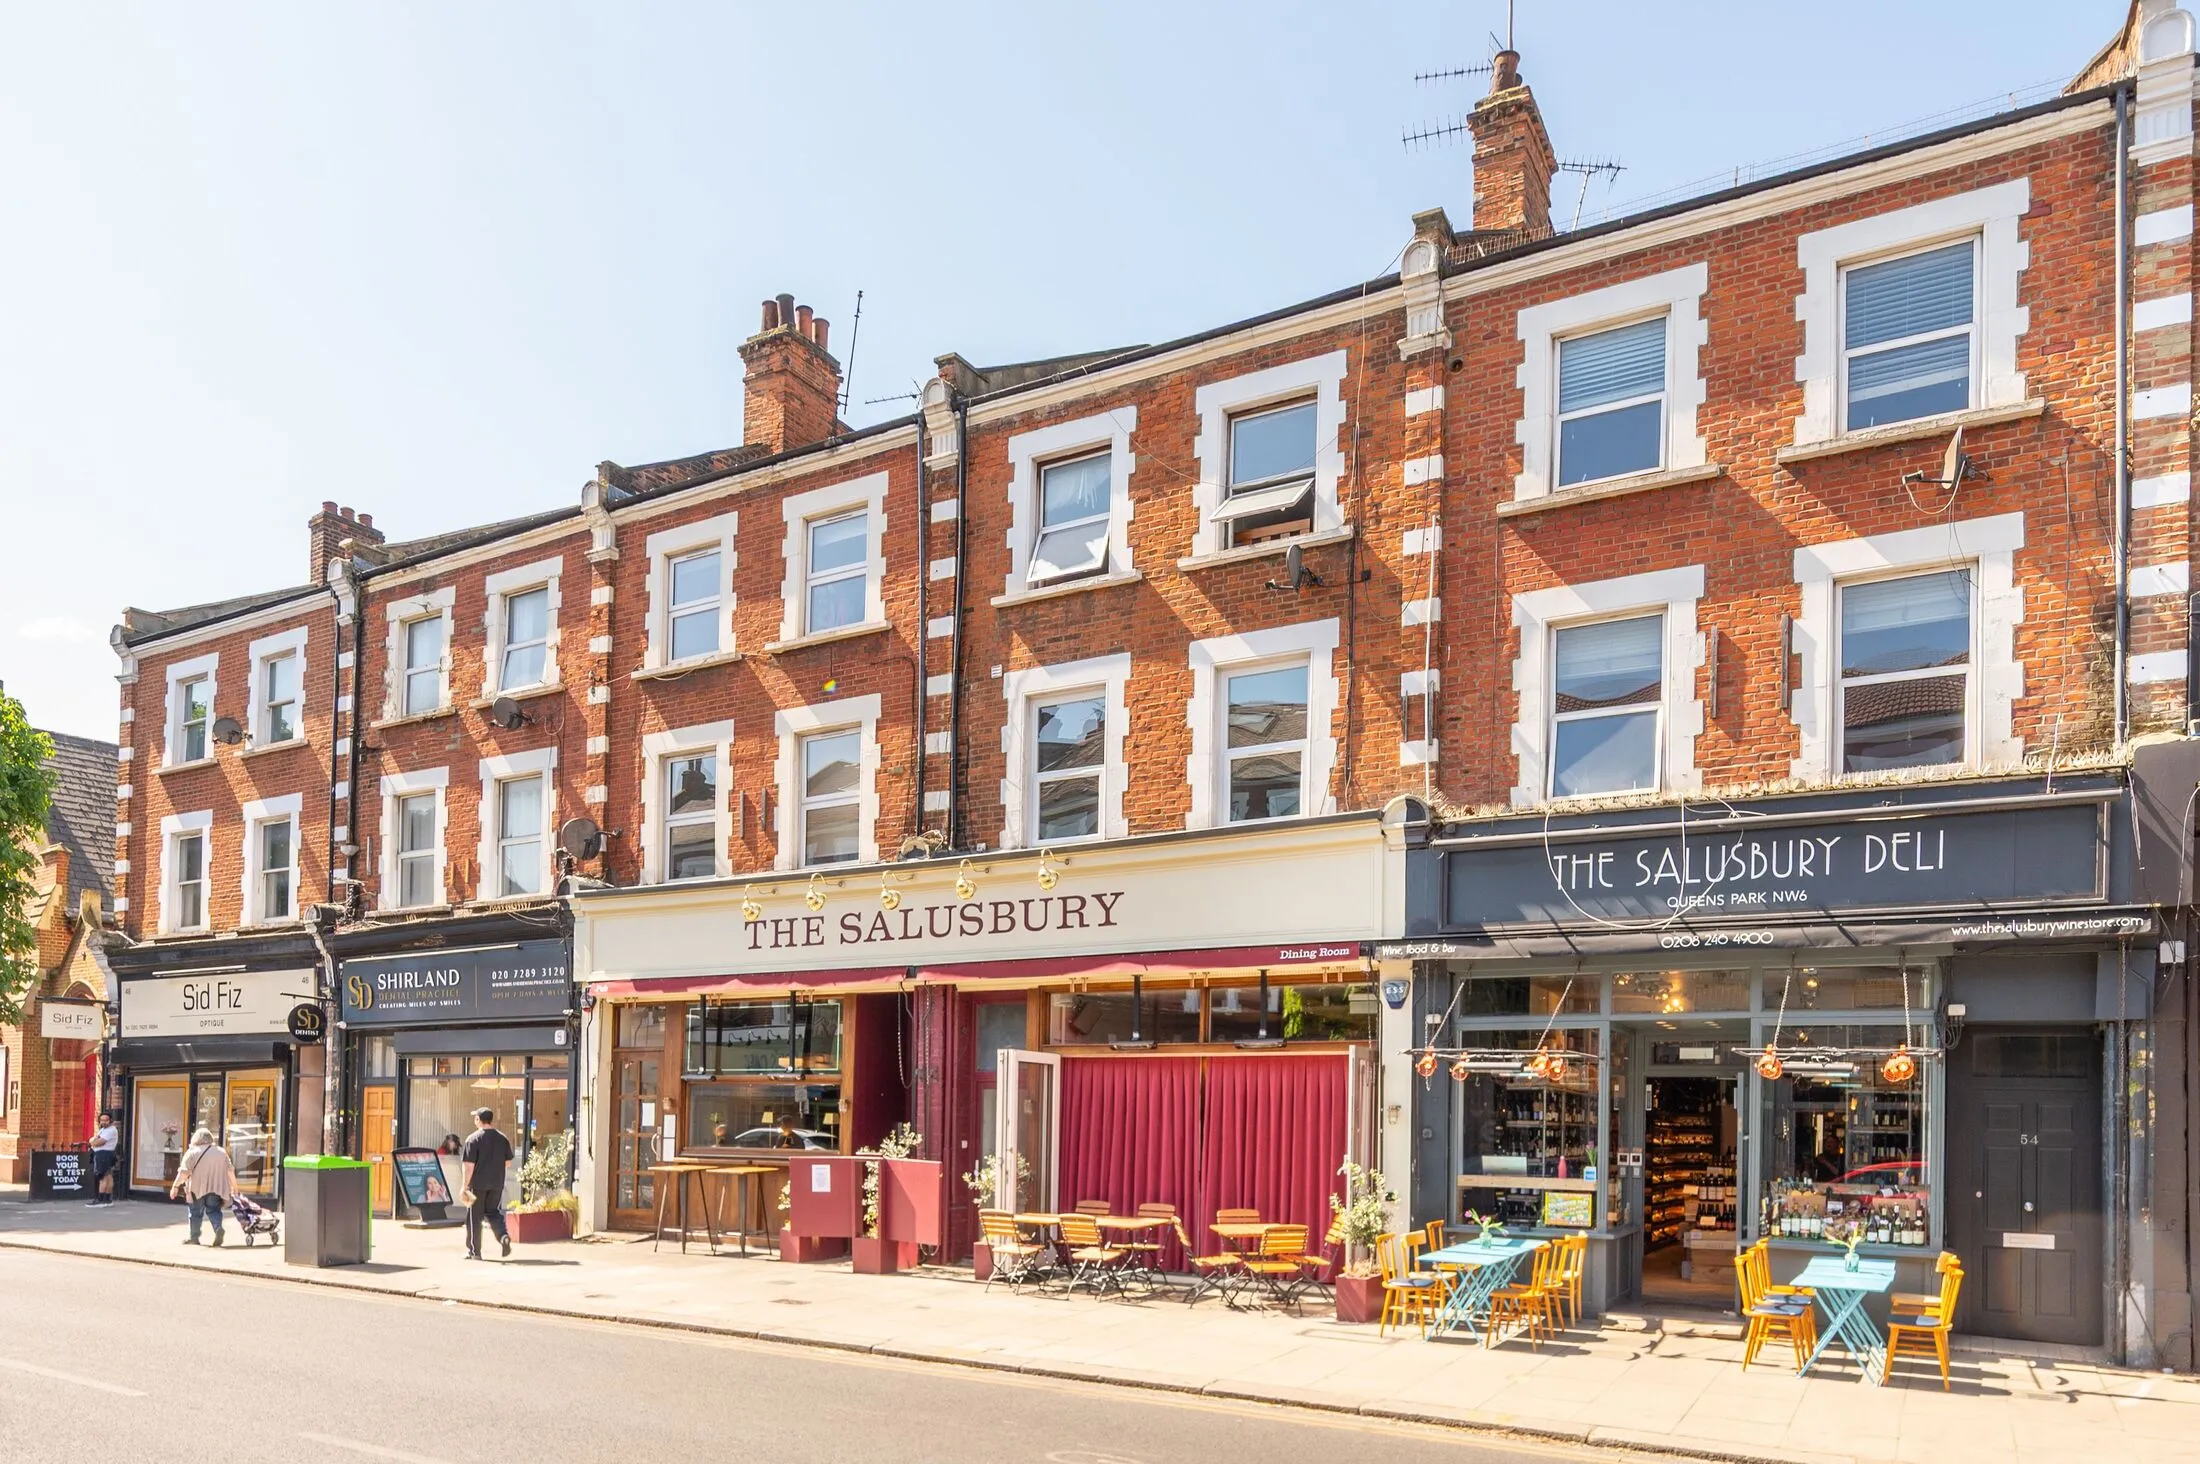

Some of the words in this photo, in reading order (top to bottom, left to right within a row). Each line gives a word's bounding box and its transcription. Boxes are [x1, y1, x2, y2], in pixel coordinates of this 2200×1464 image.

[1553, 851, 1614, 890] THE
[1635, 836, 1841, 887] SALUSBURY
[1864, 829, 1945, 874] DELI
[1667, 894, 1725, 908] QUEENS
[1730, 892, 1767, 906] PARK
[1772, 890, 1808, 903] NW6
[744, 915, 825, 950] THE
[839, 891, 1125, 946] SALUSBURY
[1660, 934, 1700, 949] 0208
[1732, 931, 1774, 945] 4900
[1280, 948, 1318, 960] Dining
[1319, 946, 1350, 957] Room
[377, 968, 461, 991] SHIRLAND
[491, 969, 509, 981] 020
[513, 968, 537, 979] 7289
[541, 966, 565, 977] 3120
[183, 983, 210, 1011] Sid
[216, 980, 242, 1009] Fiz
[378, 1002, 407, 1010] CREATING
[440, 999, 462, 1007] SMILES
[52, 1012, 73, 1024] Sid
[76, 1014, 94, 1025] Fiz
[199, 1018, 225, 1028] OPTIQUE
[2020, 1134, 2039, 1145] 54
[56, 1154, 79, 1162] BOOK
[47, 1169, 64, 1177] EYE
[66, 1168, 86, 1176] TEST
[53, 1176, 79, 1184] TODAY
